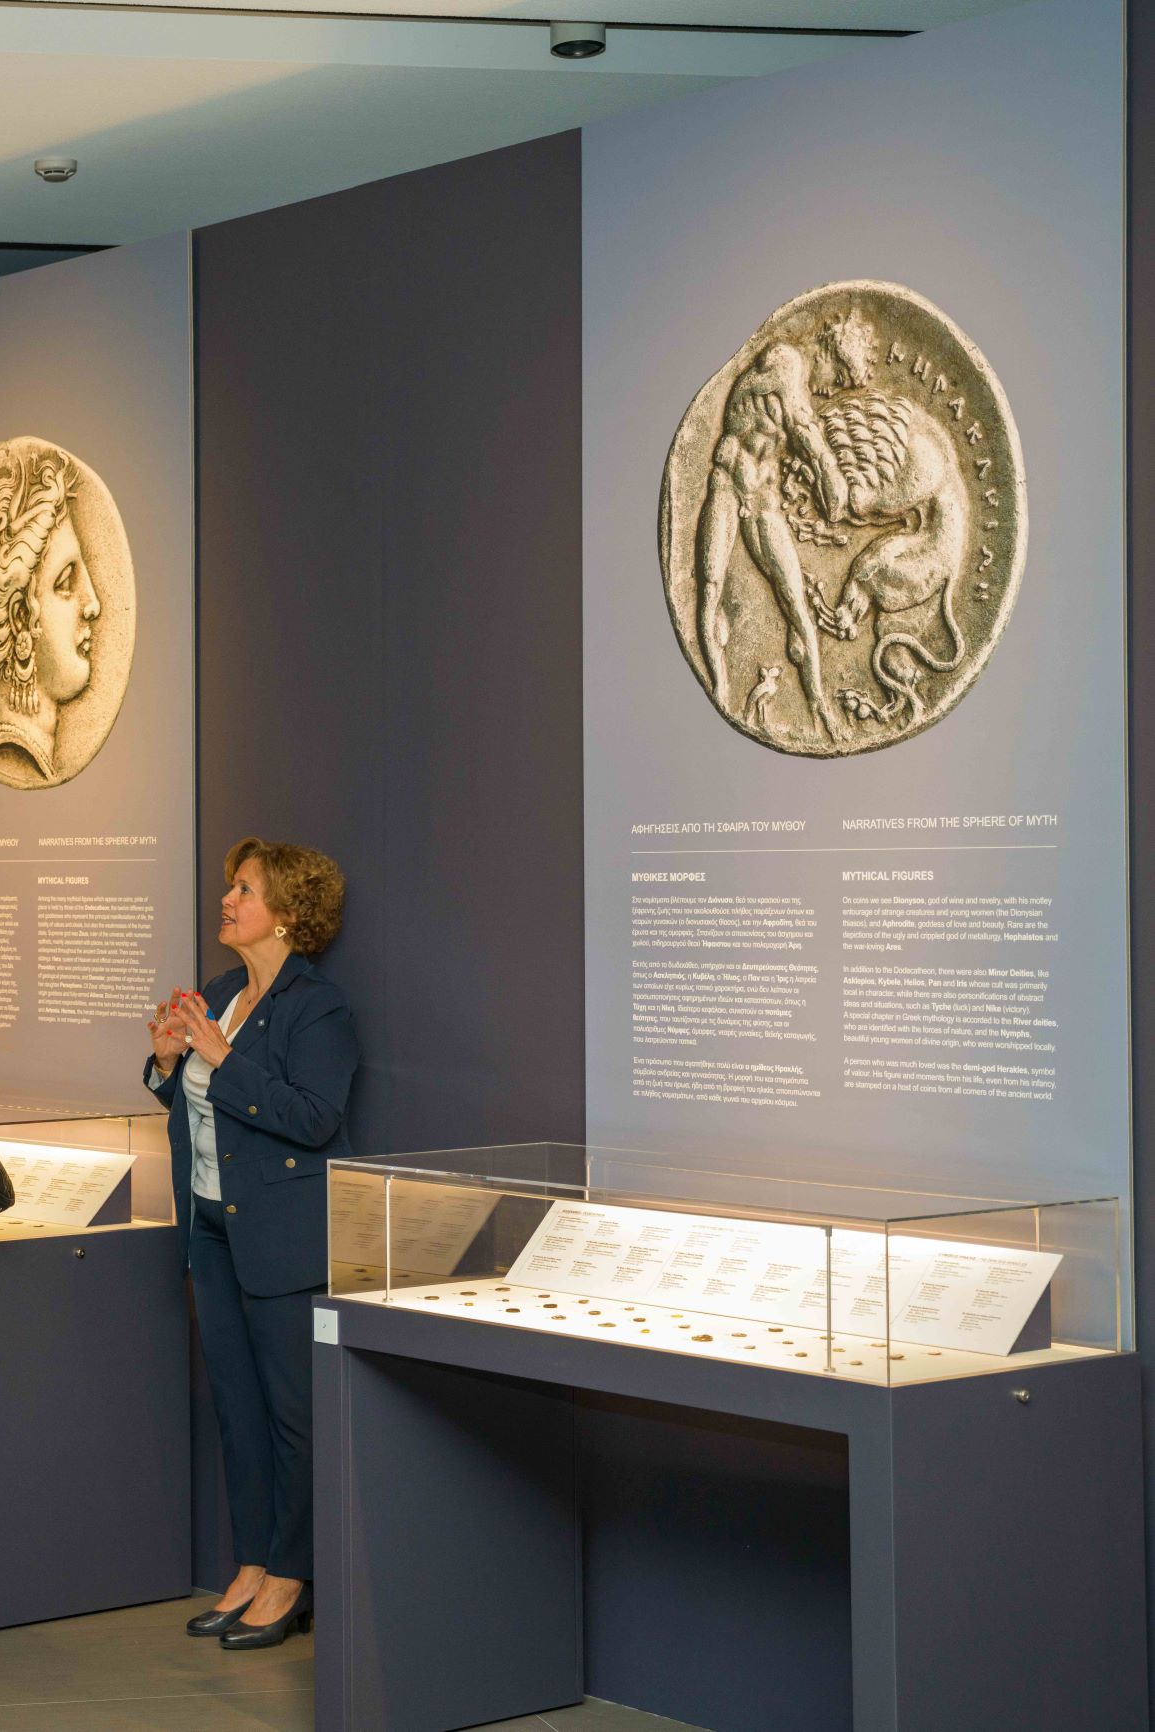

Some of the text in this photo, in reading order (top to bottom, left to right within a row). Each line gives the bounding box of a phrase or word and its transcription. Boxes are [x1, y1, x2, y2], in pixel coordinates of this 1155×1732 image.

[842, 815, 1058, 829] NARRATIVES FROM THE SPHERE OF MYTH
[632, 821, 805, 833] ΑΦΗΓΗΣΕΙΣ ΑΠΟ ΤΗ ΣΦΑΙΡΑ ΤΟΥ ΜΥΘΟΥ
[92, 837, 104, 845] THE
[105, 837, 129, 845] SPHERE
[632, 873, 705, 881] ΜΥΘΙΚΕΣ ΜΟΡΦΕΣ
[842, 871, 934, 880] MYTHICAL FIGURES
